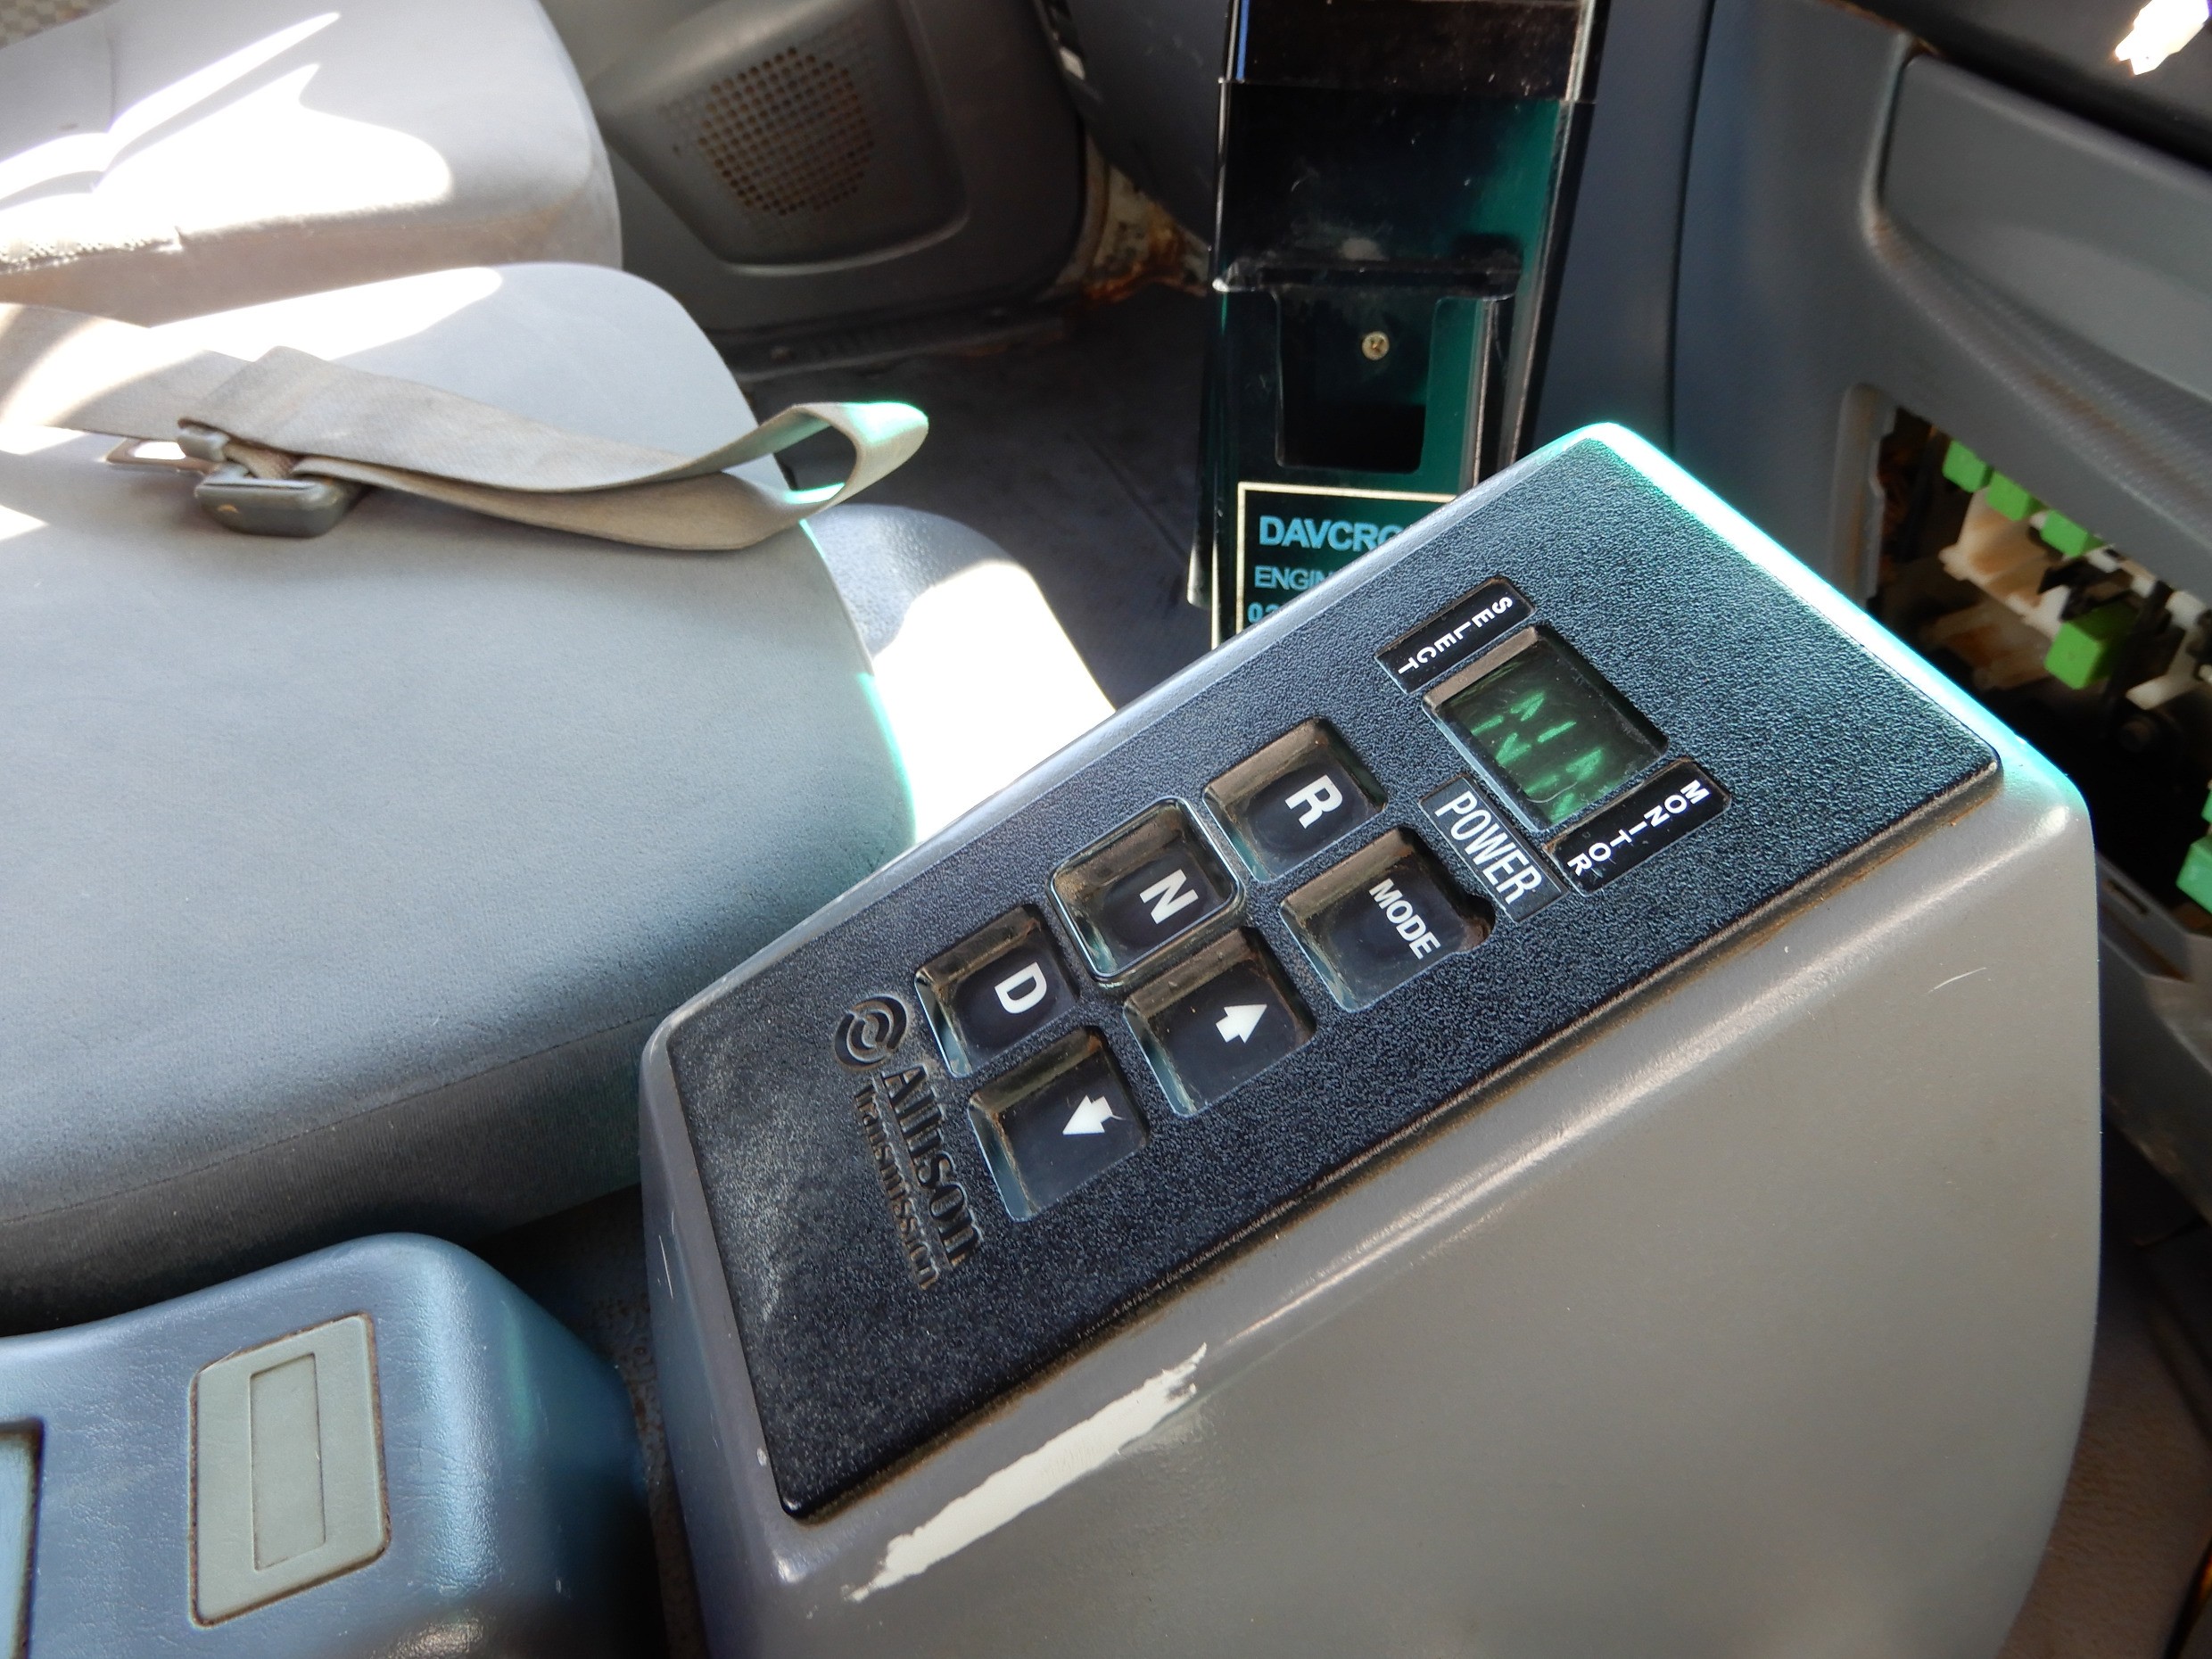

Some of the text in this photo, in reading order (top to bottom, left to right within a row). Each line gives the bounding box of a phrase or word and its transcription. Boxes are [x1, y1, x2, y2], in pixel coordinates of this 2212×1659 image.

[1398, 596, 1514, 675] SELECT
[1284, 773, 1343, 830] R
[1566, 780, 1712, 876] MONITOR
[1433, 790, 1543, 905] POWER
[1139, 868, 1200, 925] N
[1368, 877, 1441, 960] MODE
[995, 962, 1048, 1015] D
[854, 1084, 941, 1290] Transmission
[880, 1065, 983, 1267] Allison
